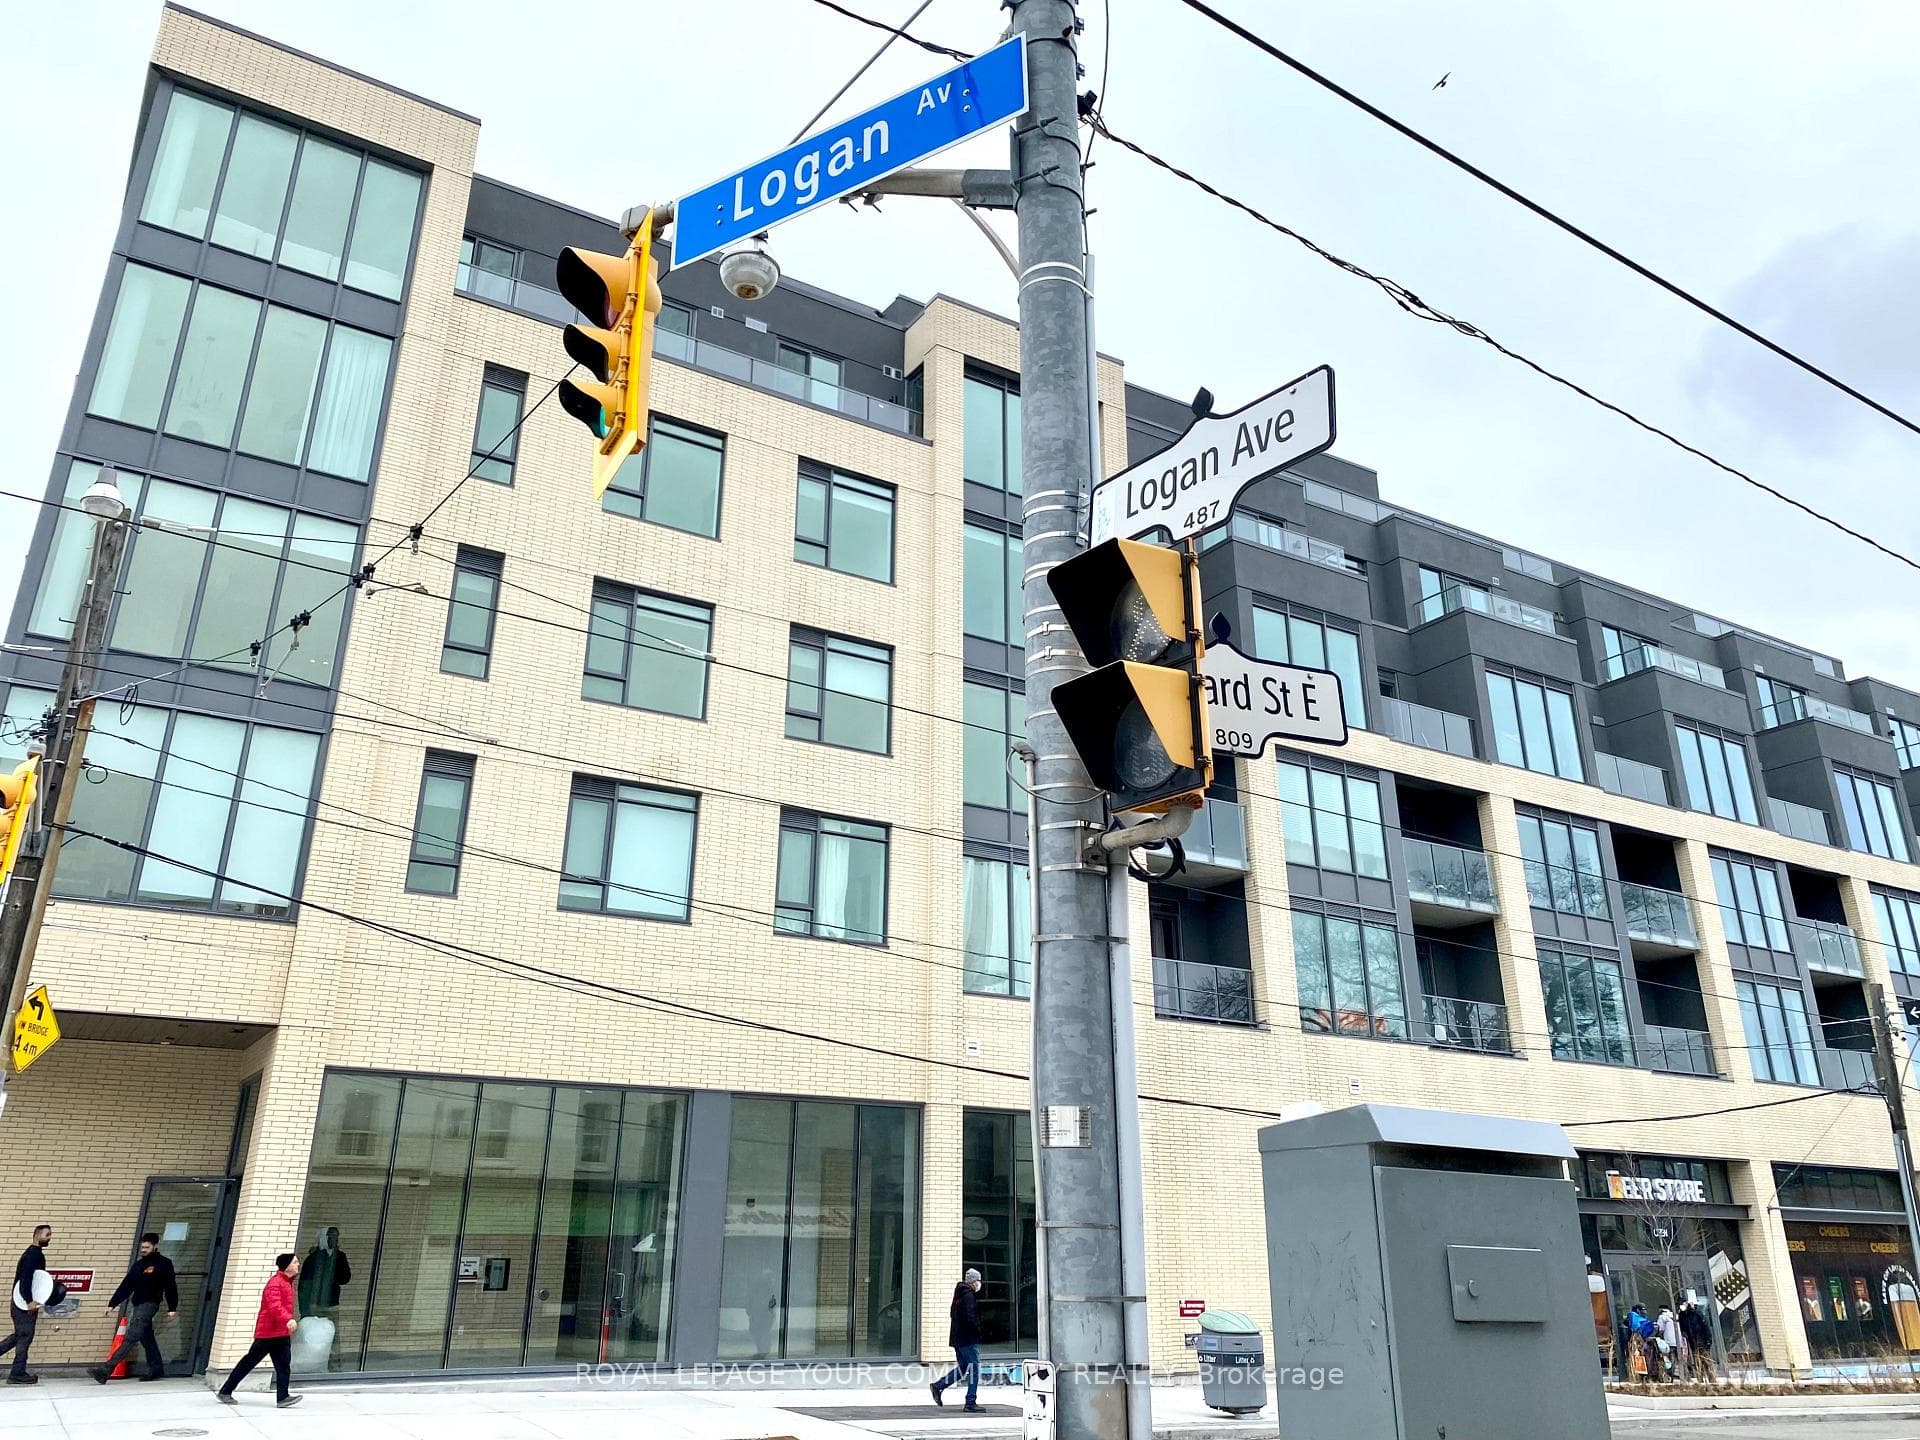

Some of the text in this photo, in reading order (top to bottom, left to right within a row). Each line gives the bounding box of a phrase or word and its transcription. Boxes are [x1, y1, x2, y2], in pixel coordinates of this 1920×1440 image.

[733, 82, 951, 221] Logan Av
[1126, 408, 1296, 519] Logan Ave
[1183, 501, 1220, 529] 487
[1205, 673, 1320, 722] ard St E
[1215, 728, 1253, 749] 809
[27, 1022, 49, 1036] BRIDGE
[1652, 1178, 1706, 1202] STORE
